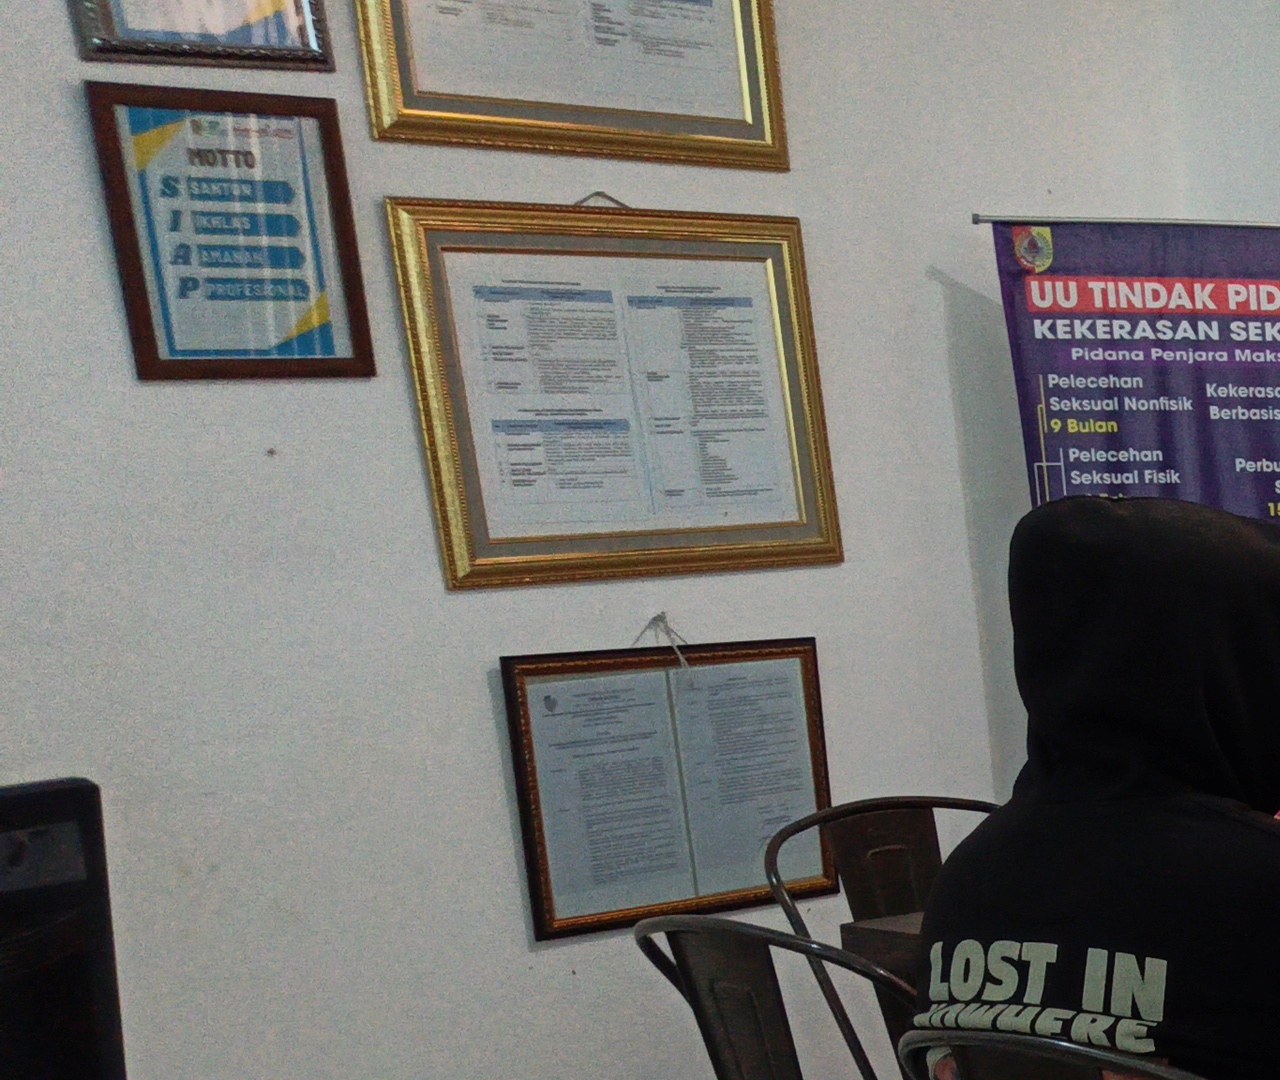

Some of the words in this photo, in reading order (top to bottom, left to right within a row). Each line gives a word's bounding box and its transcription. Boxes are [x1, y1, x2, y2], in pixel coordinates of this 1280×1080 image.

[187, 148, 257, 169] MOTTO
[1031, 281, 1078, 308] UU
[1088, 282, 1217, 310] TINDAK
[1034, 319, 1219, 341] KEKERASAN
[1071, 347, 1144, 362] Pidana
[1151, 348, 1228, 365] Penjara
[1048, 374, 1143, 389] Pelecehan
[1049, 397, 1121, 411] Seksual
[1124, 397, 1193, 412] Nonfisik
[1051, 420, 1062, 433] 9
[1068, 419, 1118, 434] Bulan
[1069, 448, 1163, 463] Pelecehan
[1071, 470, 1139, 485] Seksual
[1144, 469, 1180, 484] Fisik
[928, 938, 1058, 1005] LOST
[1081, 947, 1168, 1022] IN
